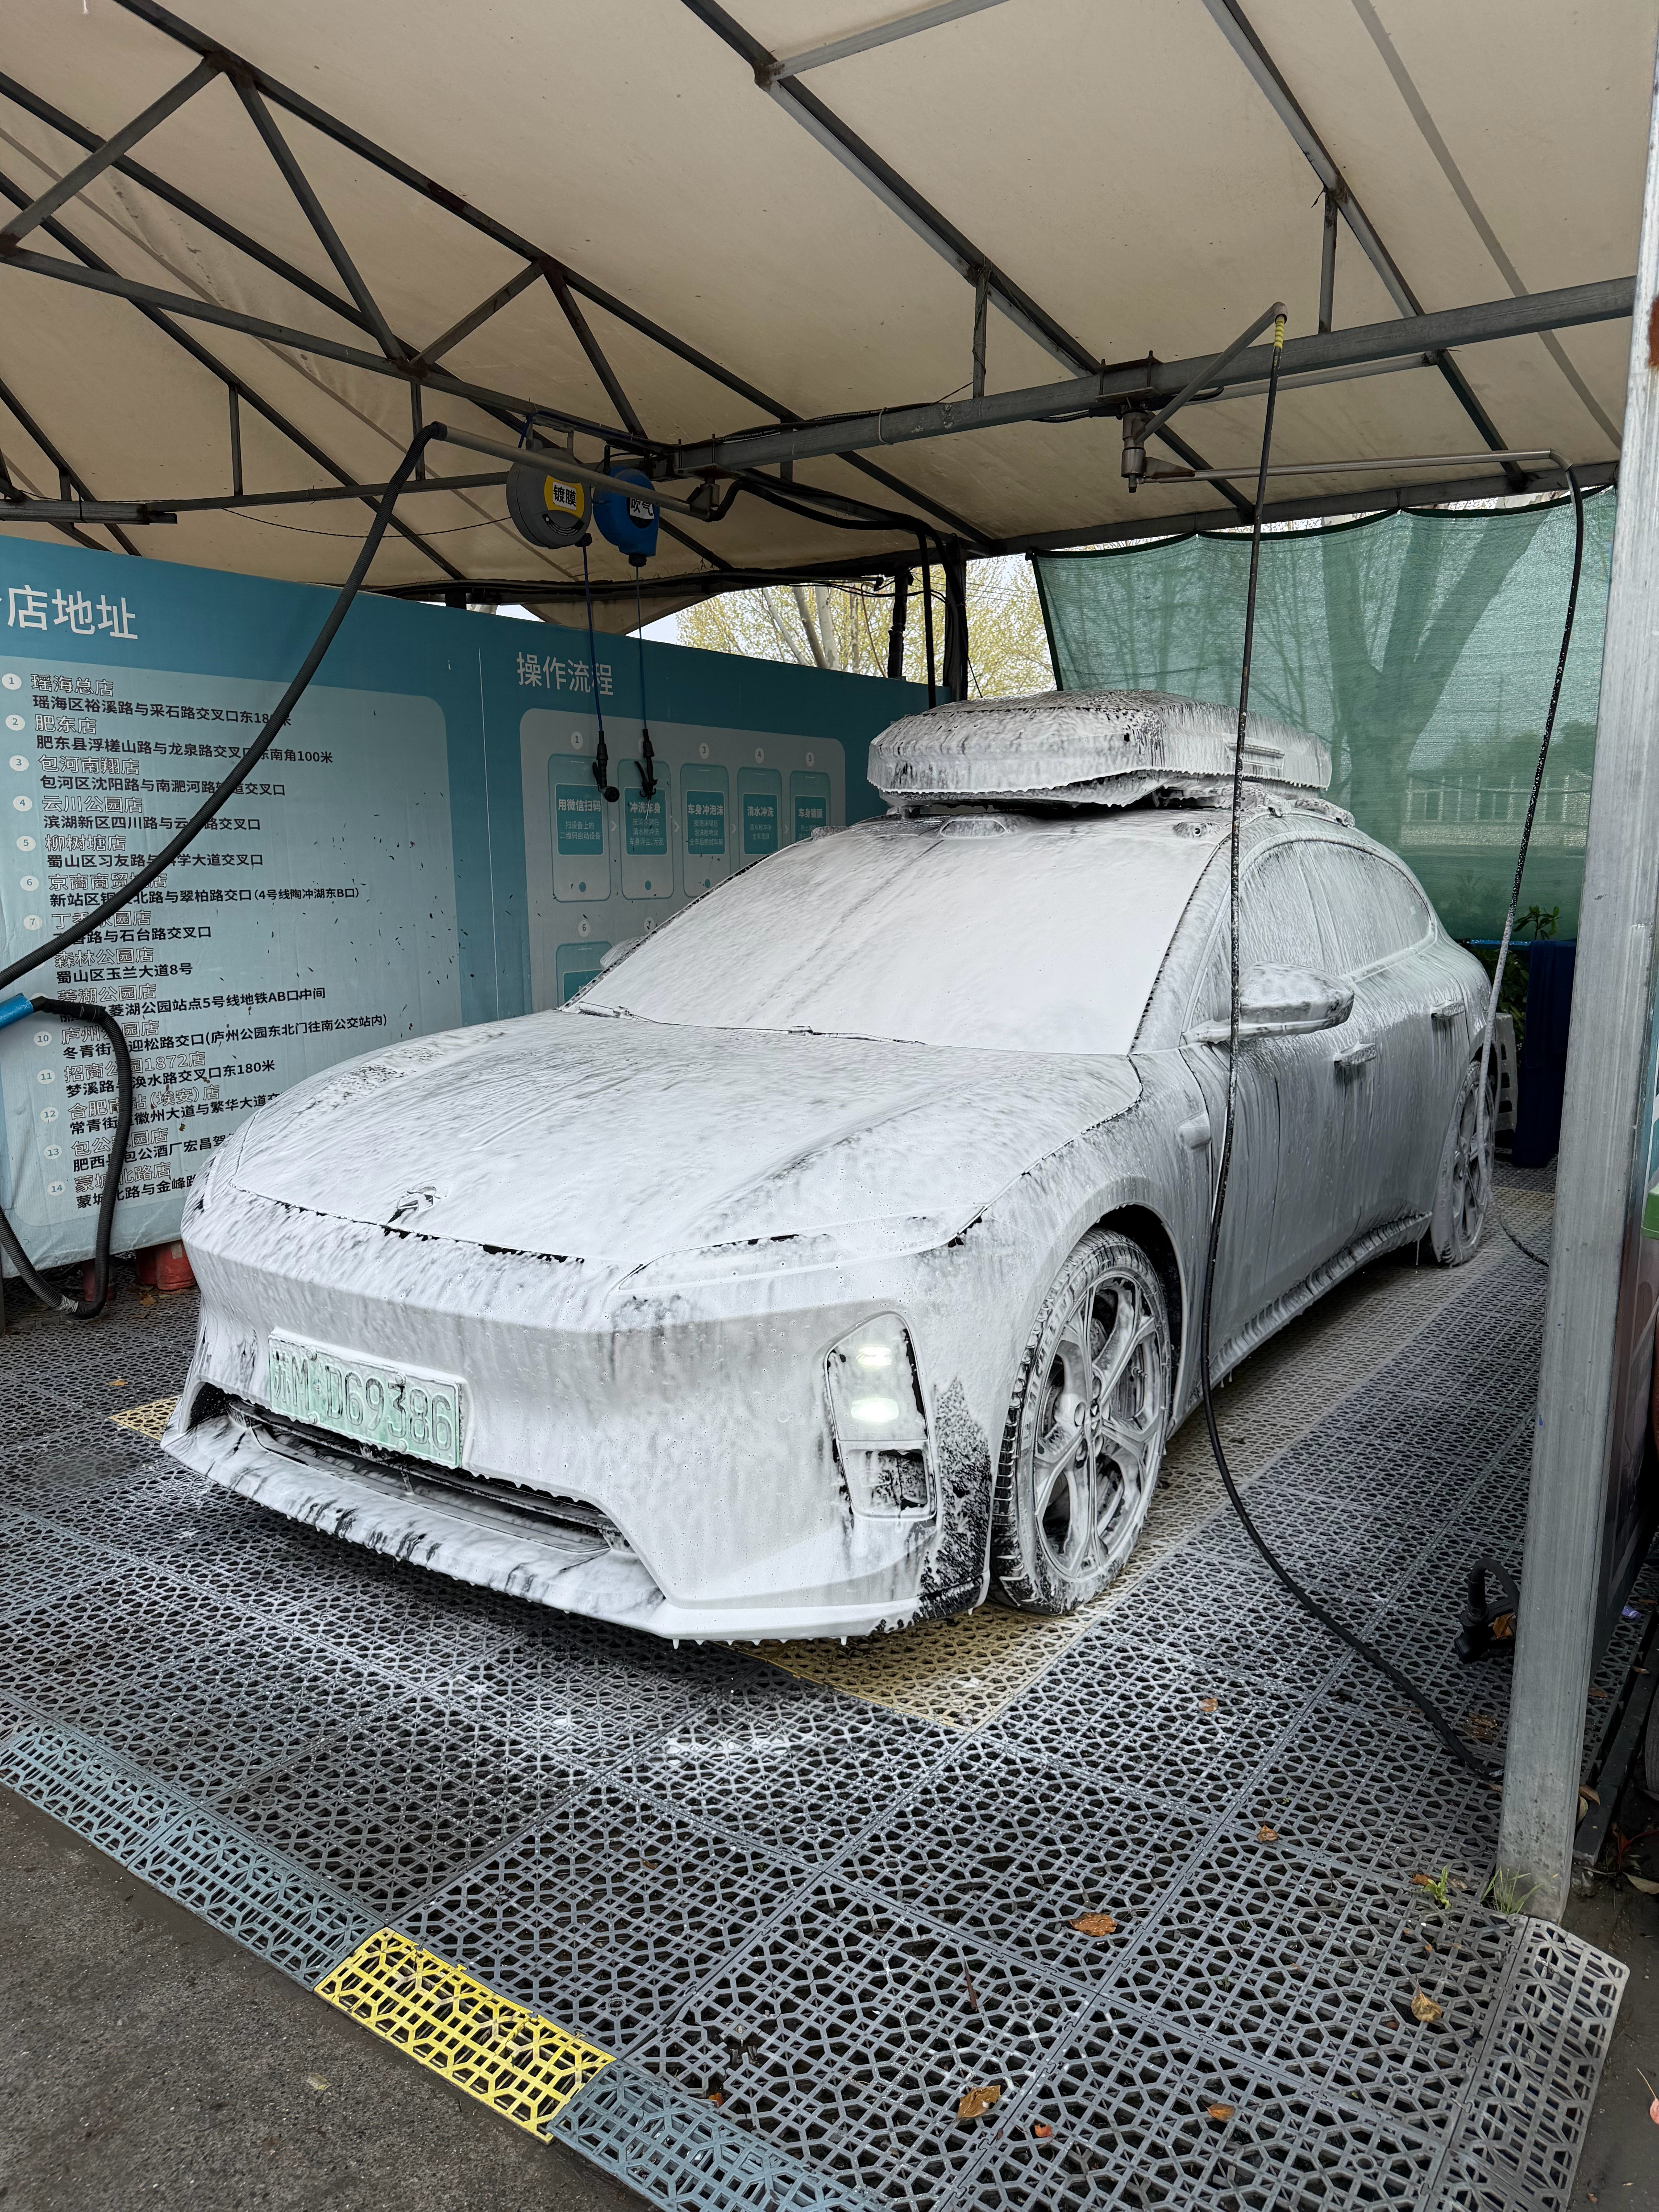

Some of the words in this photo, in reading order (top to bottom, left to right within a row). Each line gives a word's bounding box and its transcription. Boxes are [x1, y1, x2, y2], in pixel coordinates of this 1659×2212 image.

[553, 484, 576, 507] 镀膜
[631, 498, 653, 516] 吹气
[0, 585, 138, 639] 店地址
[517, 651, 614, 696] 操作流程
[31, 673, 114, 697] 瑶海总店
[33, 695, 292, 726] 瑶海区裕溪路与采石路交叉口东18米
[35, 714, 97, 735] 肥东店
[38, 754, 139, 775] 包河南翔店
[42, 795, 143, 814] 云川公园店
[558, 799, 601, 812] 用微信扫码
[630, 802, 661, 814] 冲洗车身
[688, 804, 723, 816] 车身冲泡沫
[748, 806, 774, 817] 清水冲洗
[43, 815, 261, 831] 滨湖新区四川路与云路交叉口
[565, 821, 594, 830] 扫设备上的
[45, 834, 126, 852] 柳树塘店
[560, 832, 601, 840] 二维码启动设备
[50, 886, 360, 907] 新站区铜北路与翠柏路交口(4号线陶冲湖东B口)
[29, 918, 35, 926] 7
[53, 926, 211, 946] 路与石台路交叉口
[54, 946, 155, 968] 森林公园店
[56, 963, 193, 985] 蜀山区玉兰大道8号
[57, 983, 156, 1005] 菱湖公园店
[37, 1034, 49, 1043] 10
[63, 1014, 388, 1060] 冬青街迎松路交口(庐州公园东北门往南公交站内)
[41, 1072, 52, 1080] 11
[66, 1059, 275, 1098] 梦溪路涣水路交叉口东180米
[43, 1110, 56, 1118] 12
[48, 1148, 60, 1156] 13
[73, 1133, 235, 1172] 肥西包公酒厂宏昌驾
[51, 1184, 63, 1192] 14
